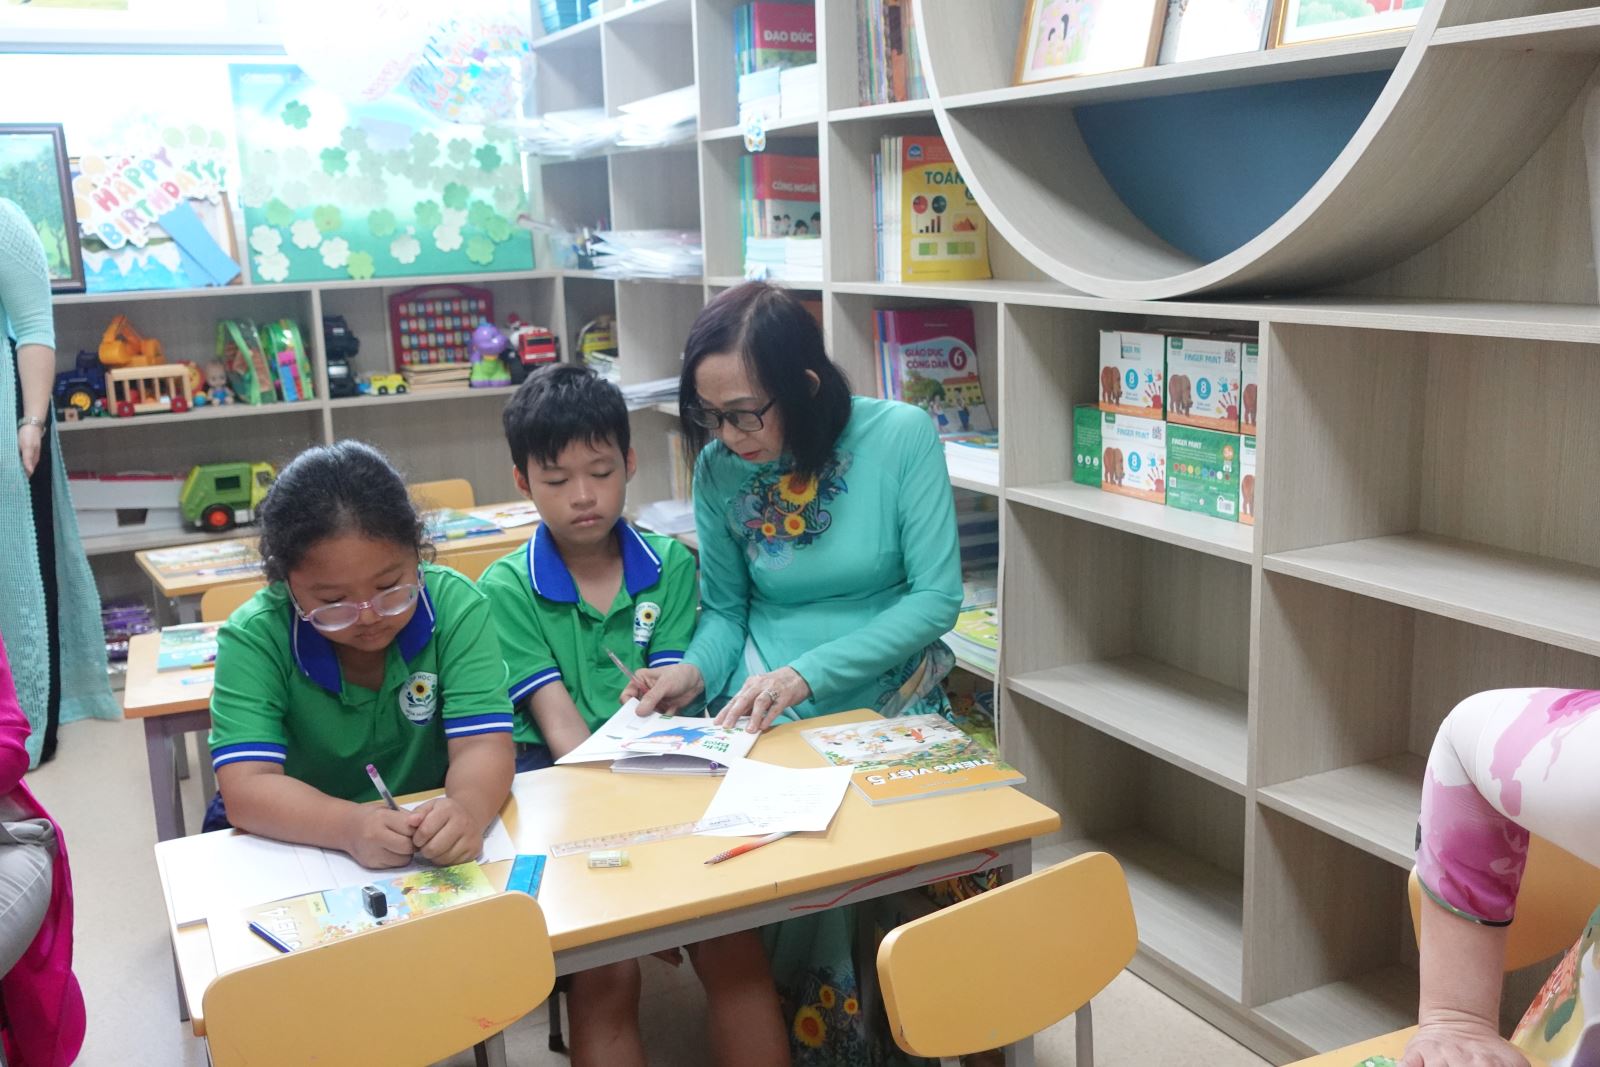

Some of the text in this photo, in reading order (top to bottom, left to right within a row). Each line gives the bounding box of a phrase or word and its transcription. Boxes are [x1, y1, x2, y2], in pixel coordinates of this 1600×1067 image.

[92, 147, 173, 213] HAPPY
[953, 350, 964, 366] 6
[1184, 353, 1222, 365] FINGER PAINT
[1129, 371, 1136, 385] 8
[1200, 381, 1207, 394] 8
[1116, 428, 1135, 437] FINGER
[1171, 437, 1188, 447] FINGER
[1131, 453, 1138, 467] 8
[934, 758, 995, 774] TIẾNG
[865, 774, 886, 786] 5
[887, 767, 934, 782] VIỆT
